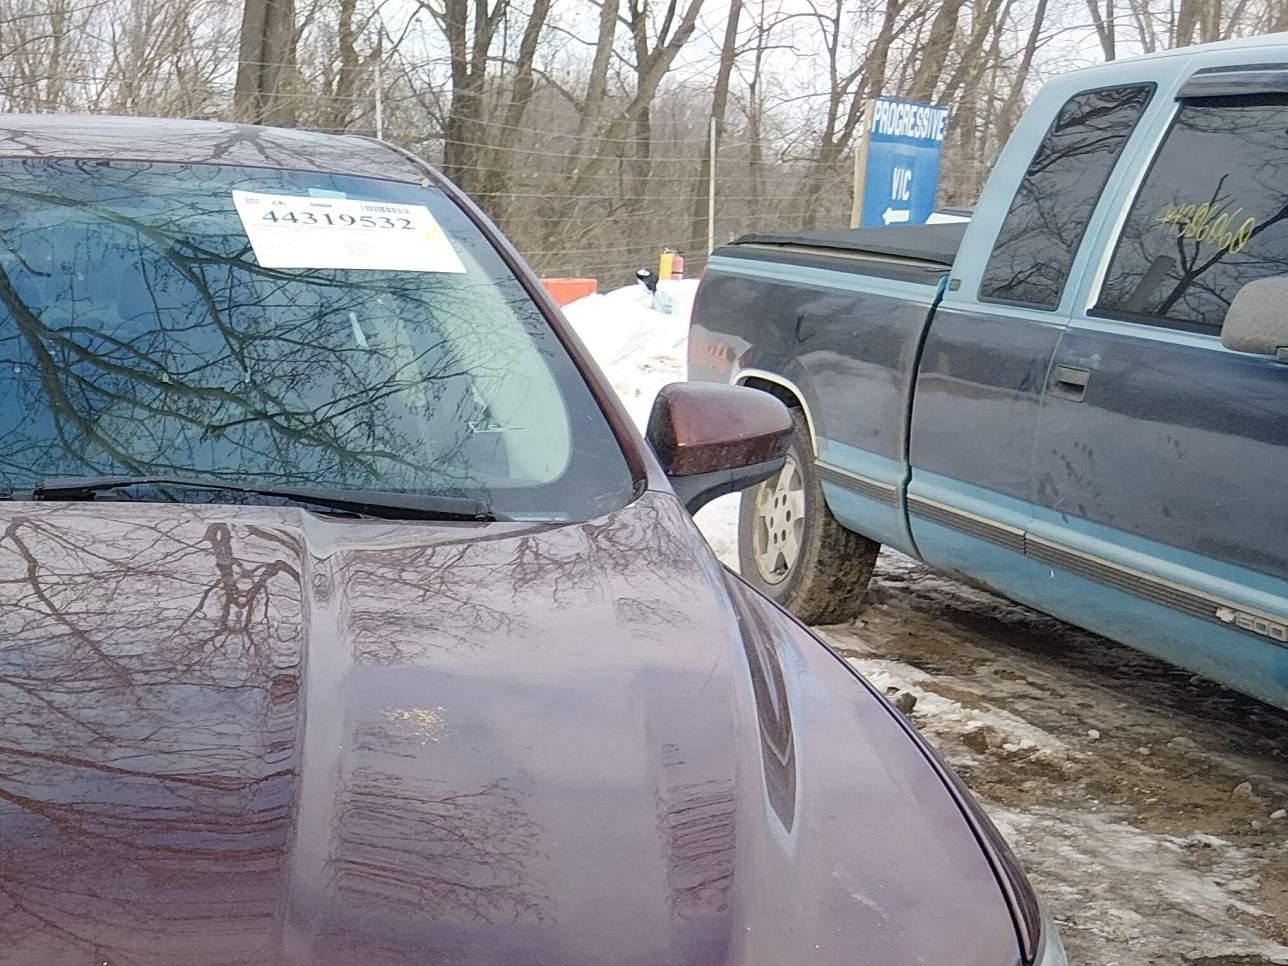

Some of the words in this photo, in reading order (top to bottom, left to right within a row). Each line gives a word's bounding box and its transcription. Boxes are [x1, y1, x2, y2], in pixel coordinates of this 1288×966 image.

[871, 100, 949, 141] PROGRESSIVE
[892, 167, 912, 201] VIC
[262, 208, 417, 231] 44319532
